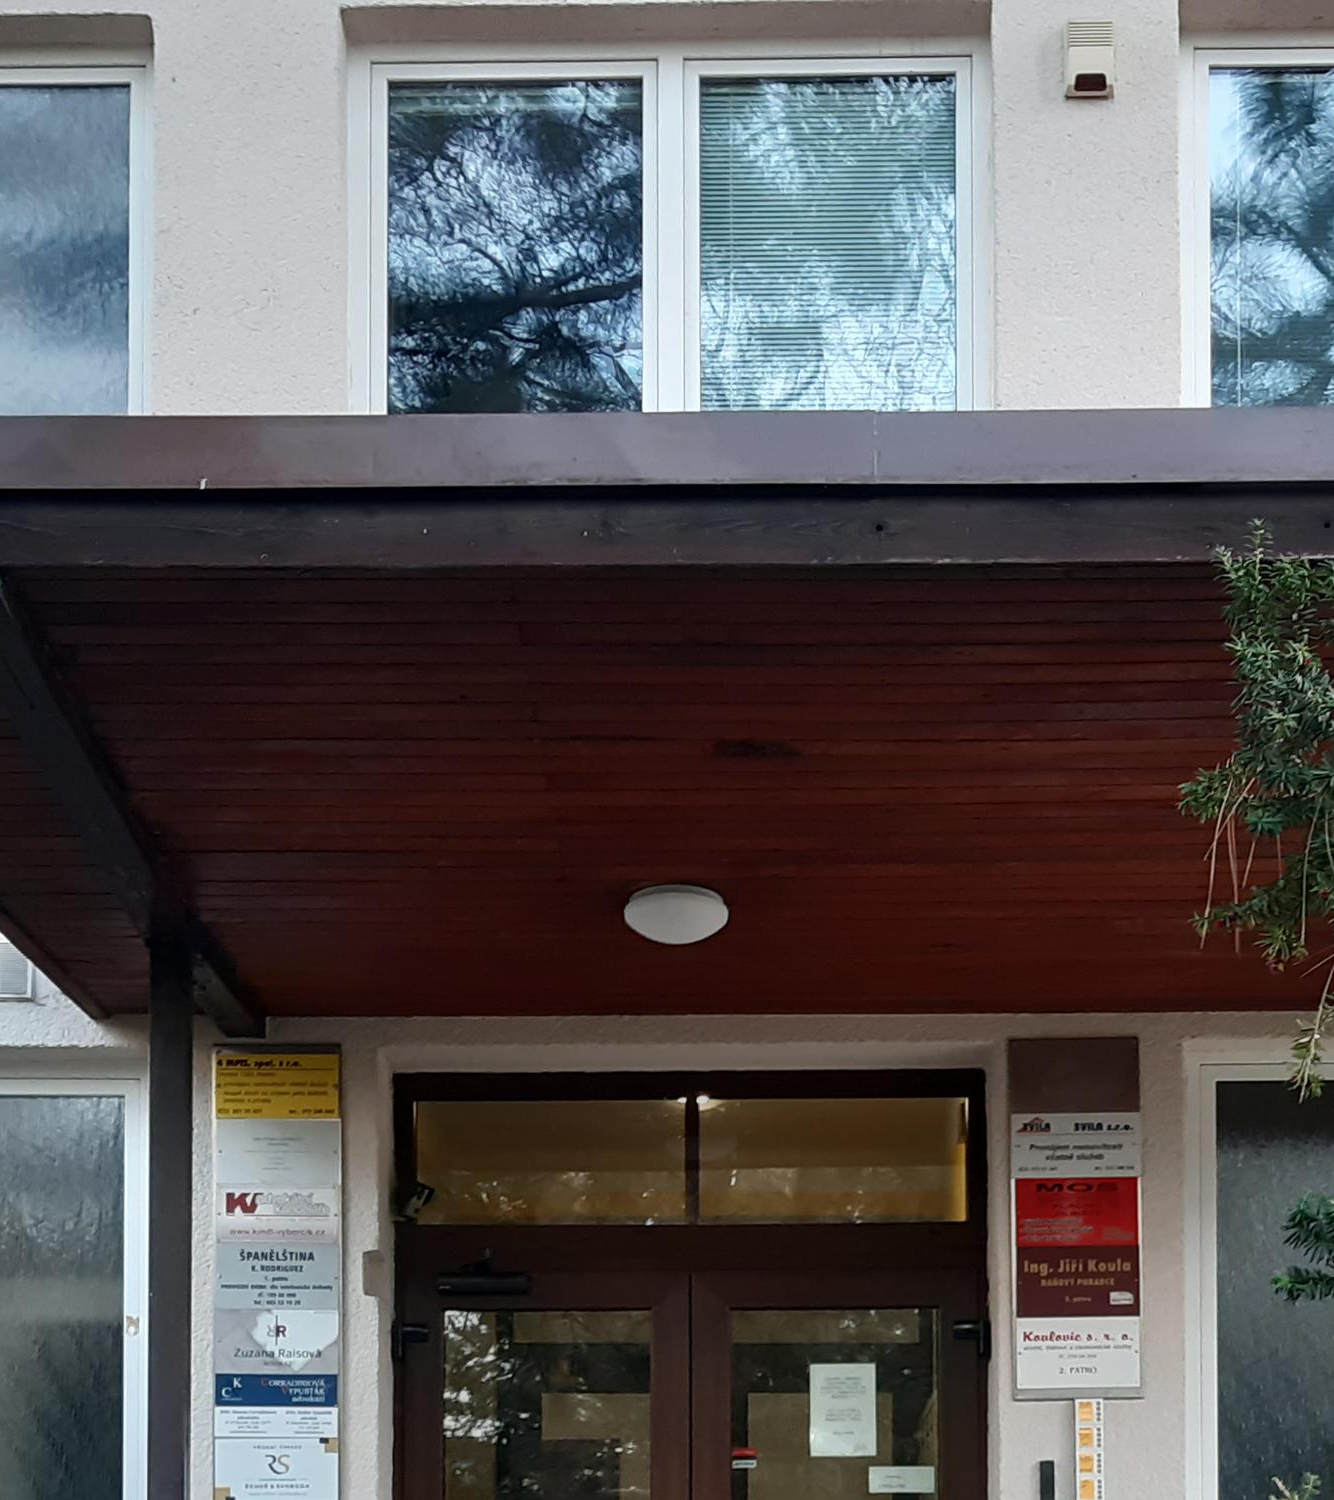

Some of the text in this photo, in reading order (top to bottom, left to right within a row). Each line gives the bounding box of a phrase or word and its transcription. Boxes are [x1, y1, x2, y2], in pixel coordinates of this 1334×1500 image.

[239, 1248, 316, 1262] ŠPANĚLŠTINA
[261, 1265, 304, 1273] RODRIGUEZ
[1023, 1258, 1132, 1277] Ing. Jiří Koula
